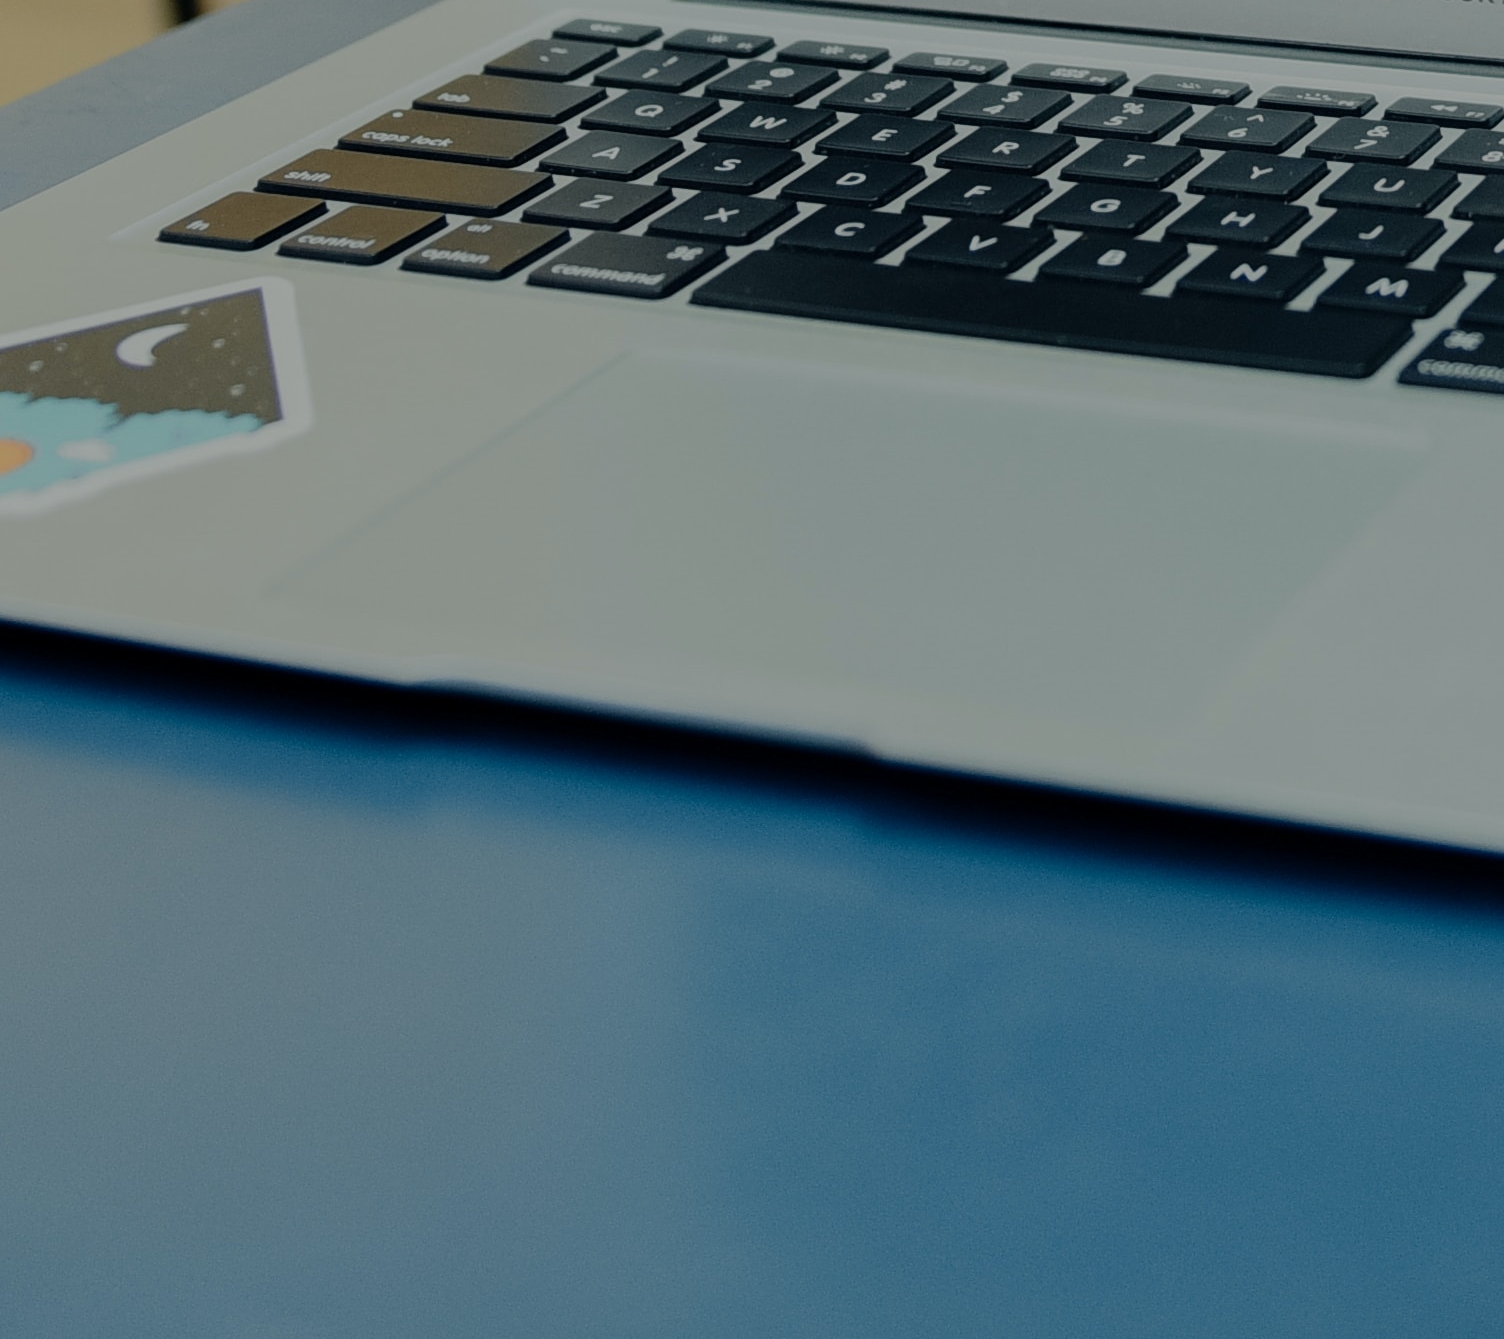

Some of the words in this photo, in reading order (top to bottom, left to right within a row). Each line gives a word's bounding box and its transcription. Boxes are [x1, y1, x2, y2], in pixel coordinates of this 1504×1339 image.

[747, 79, 773, 91] 2
[863, 92, 887, 104] 3
[634, 104, 664, 118] Q
[749, 115, 788, 130] W
[1103, 115, 1129, 127] 5
[361, 131, 411, 143] caps
[410, 135, 454, 148] lock
[871, 128, 899, 142] E
[1227, 127, 1249, 138] 6
[991, 141, 1020, 155] R
[1353, 138, 1378, 150] 7
[591, 146, 621, 160] A
[1122, 154, 1146, 167] T
[713, 158, 742, 172] S
[1250, 165, 1274, 180] Y
[283, 170, 331, 183] shift
[835, 172, 867, 186] D
[963, 185, 992, 198] F
[1373, 177, 1405, 193] U
[579, 194, 614, 209] Z
[1090, 198, 1122, 213] G
[703, 207, 740, 223] X
[1220, 211, 1256, 228] H
[834, 222, 866, 237] C
[1358, 225, 1384, 240] J
[297, 234, 376, 250] control
[968, 235, 998, 252] V
[420, 248, 491, 265] option
[1097, 249, 1127, 266] B
[551, 264, 665, 285] command
[1231, 264, 1267, 281] N
[1366, 278, 1408, 297] M
